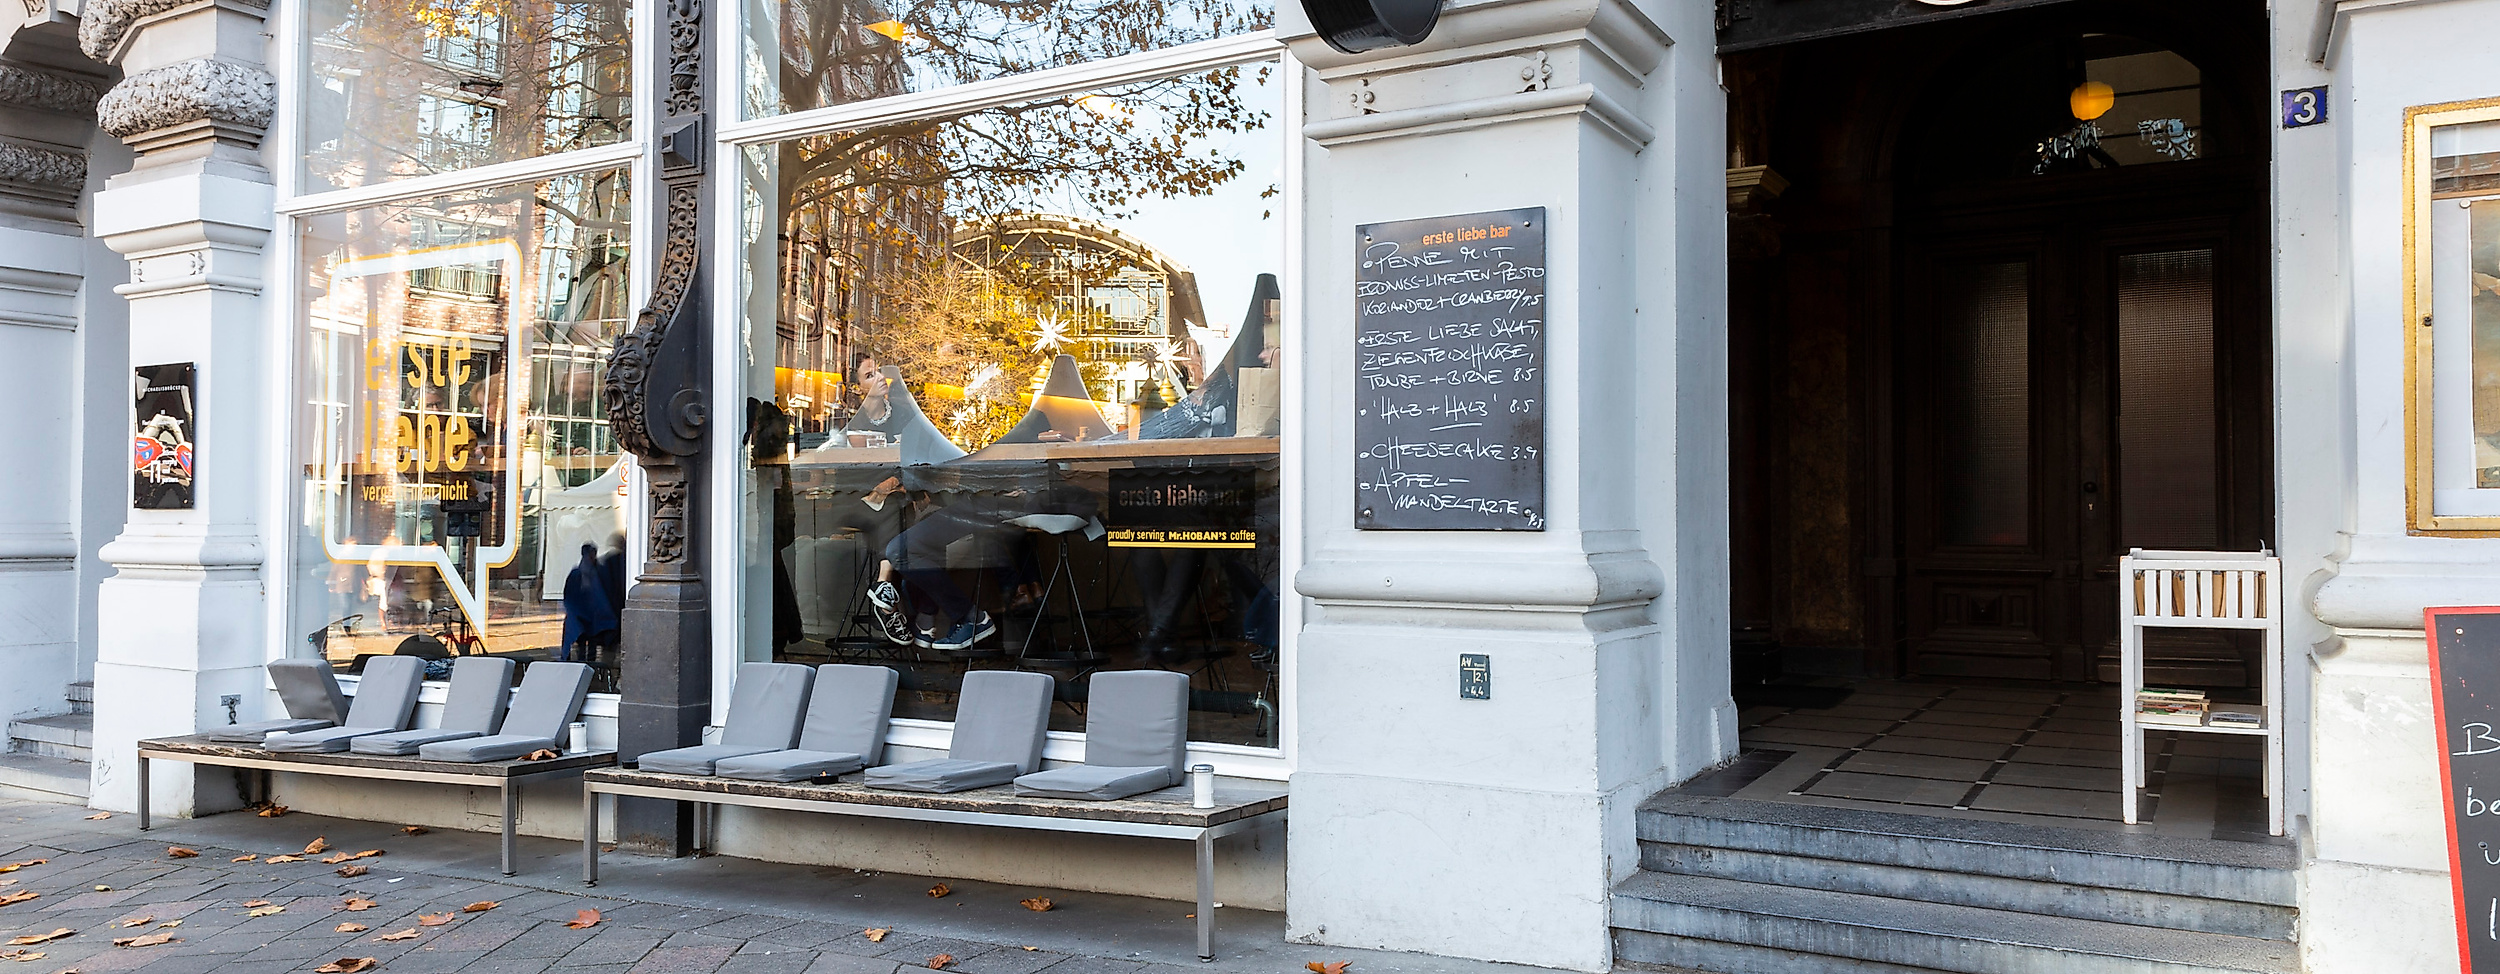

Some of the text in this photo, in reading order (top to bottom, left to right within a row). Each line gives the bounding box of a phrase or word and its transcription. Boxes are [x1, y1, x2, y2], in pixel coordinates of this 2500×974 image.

[2294, 91, 2317, 123] 3
[1422, 225, 1512, 246] erste liebe bar
[1366, 241, 1515, 274] PENNE MIT
[1364, 330, 1421, 348] ERSTE
[1428, 323, 1482, 341] LIEBE
[365, 334, 471, 391] erste
[1362, 374, 1425, 390] TRAUBE
[1447, 369, 1504, 386] BIRNE
[1512, 367, 1537, 382] 8.5
[1426, 404, 1440, 414] +
[1509, 399, 1535, 413] 8.5
[364, 397, 469, 473] liebe
[1371, 435, 1506, 470] CHEESECAKE
[439, 480, 469, 501] nicht
[1119, 486, 1161, 507] erste
[1167, 484, 1208, 507] liebe
[1394, 493, 1519, 516] MANDELTARTE
[1108, 529, 1256, 542] proudly serving Mr.HOBAN'S coffee
